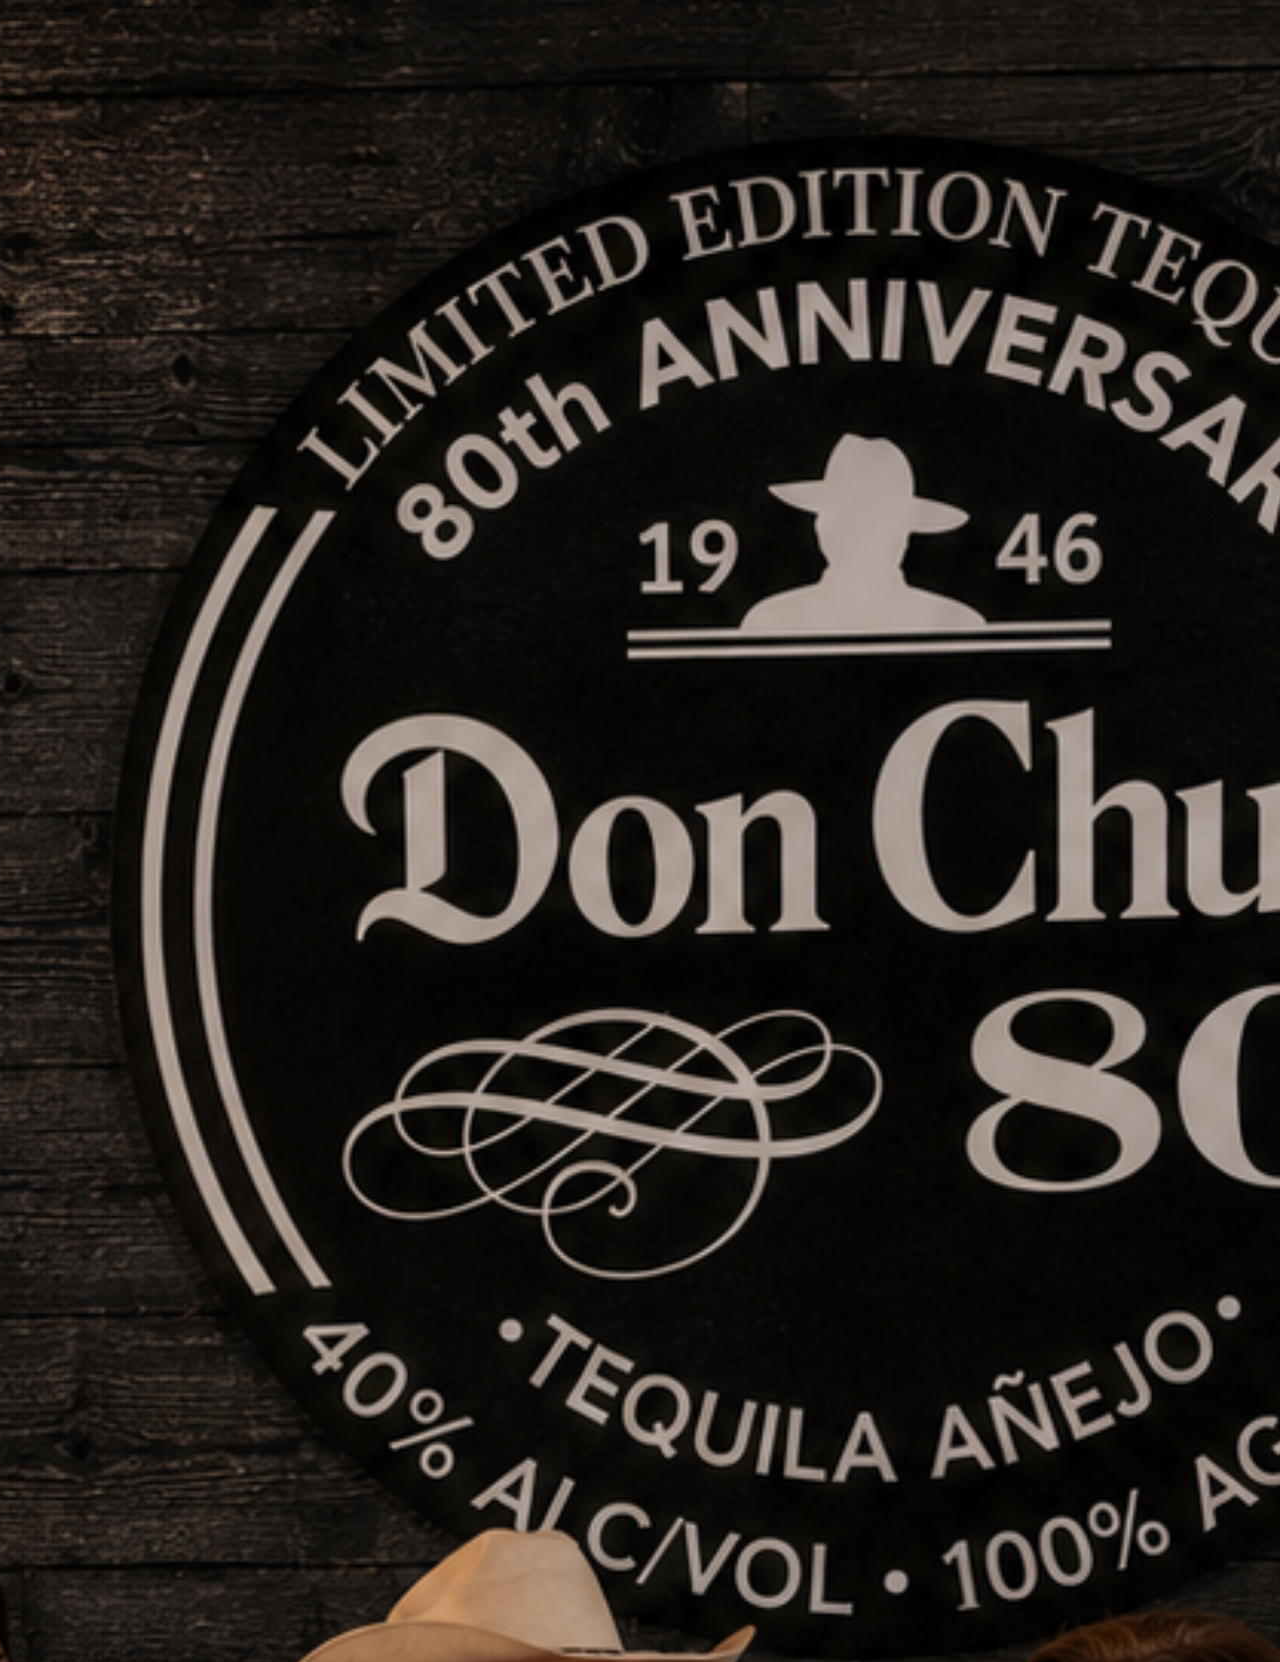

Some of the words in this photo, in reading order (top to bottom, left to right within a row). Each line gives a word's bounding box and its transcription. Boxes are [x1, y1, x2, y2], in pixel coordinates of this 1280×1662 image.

[297, 216, 649, 490] LIMITED
[670, 167, 1067, 261] EDITION
[397, 373, 612, 560] 80th
[639, 519, 739, 593] 19
[995, 512, 1102, 585] 46
[340, 713, 831, 945] Don
[302, 1322, 474, 1479] 40%
[942, 1488, 1170, 1610] 100%
[529, 1313, 897, 1483] TEQUILA
[931, 1311, 1213, 1479] AÑEJO
